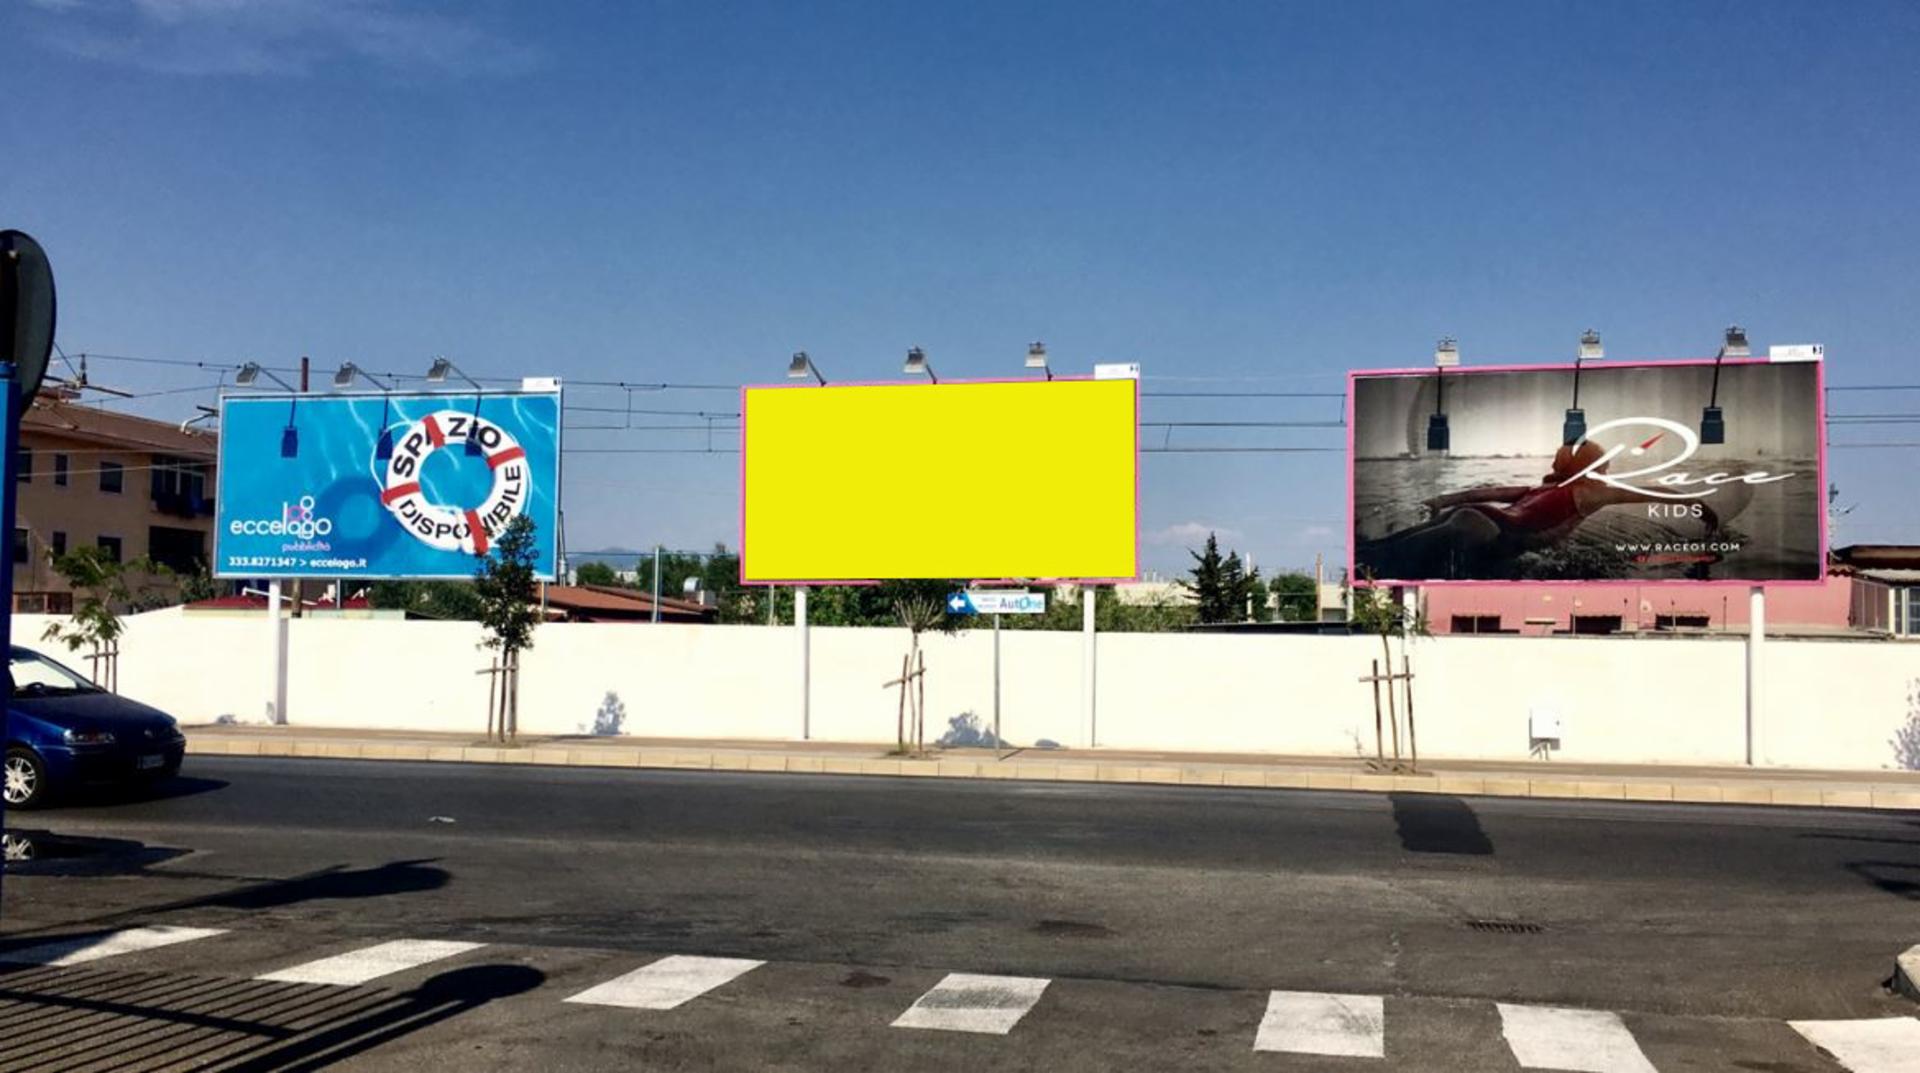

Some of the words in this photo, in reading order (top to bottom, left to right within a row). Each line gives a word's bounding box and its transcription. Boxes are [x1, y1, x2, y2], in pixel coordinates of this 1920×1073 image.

[1558, 417, 1796, 498] Race
[1648, 503, 1704, 518] KIDS
[1615, 542, 1740, 552] WWW.RACE01.COM
